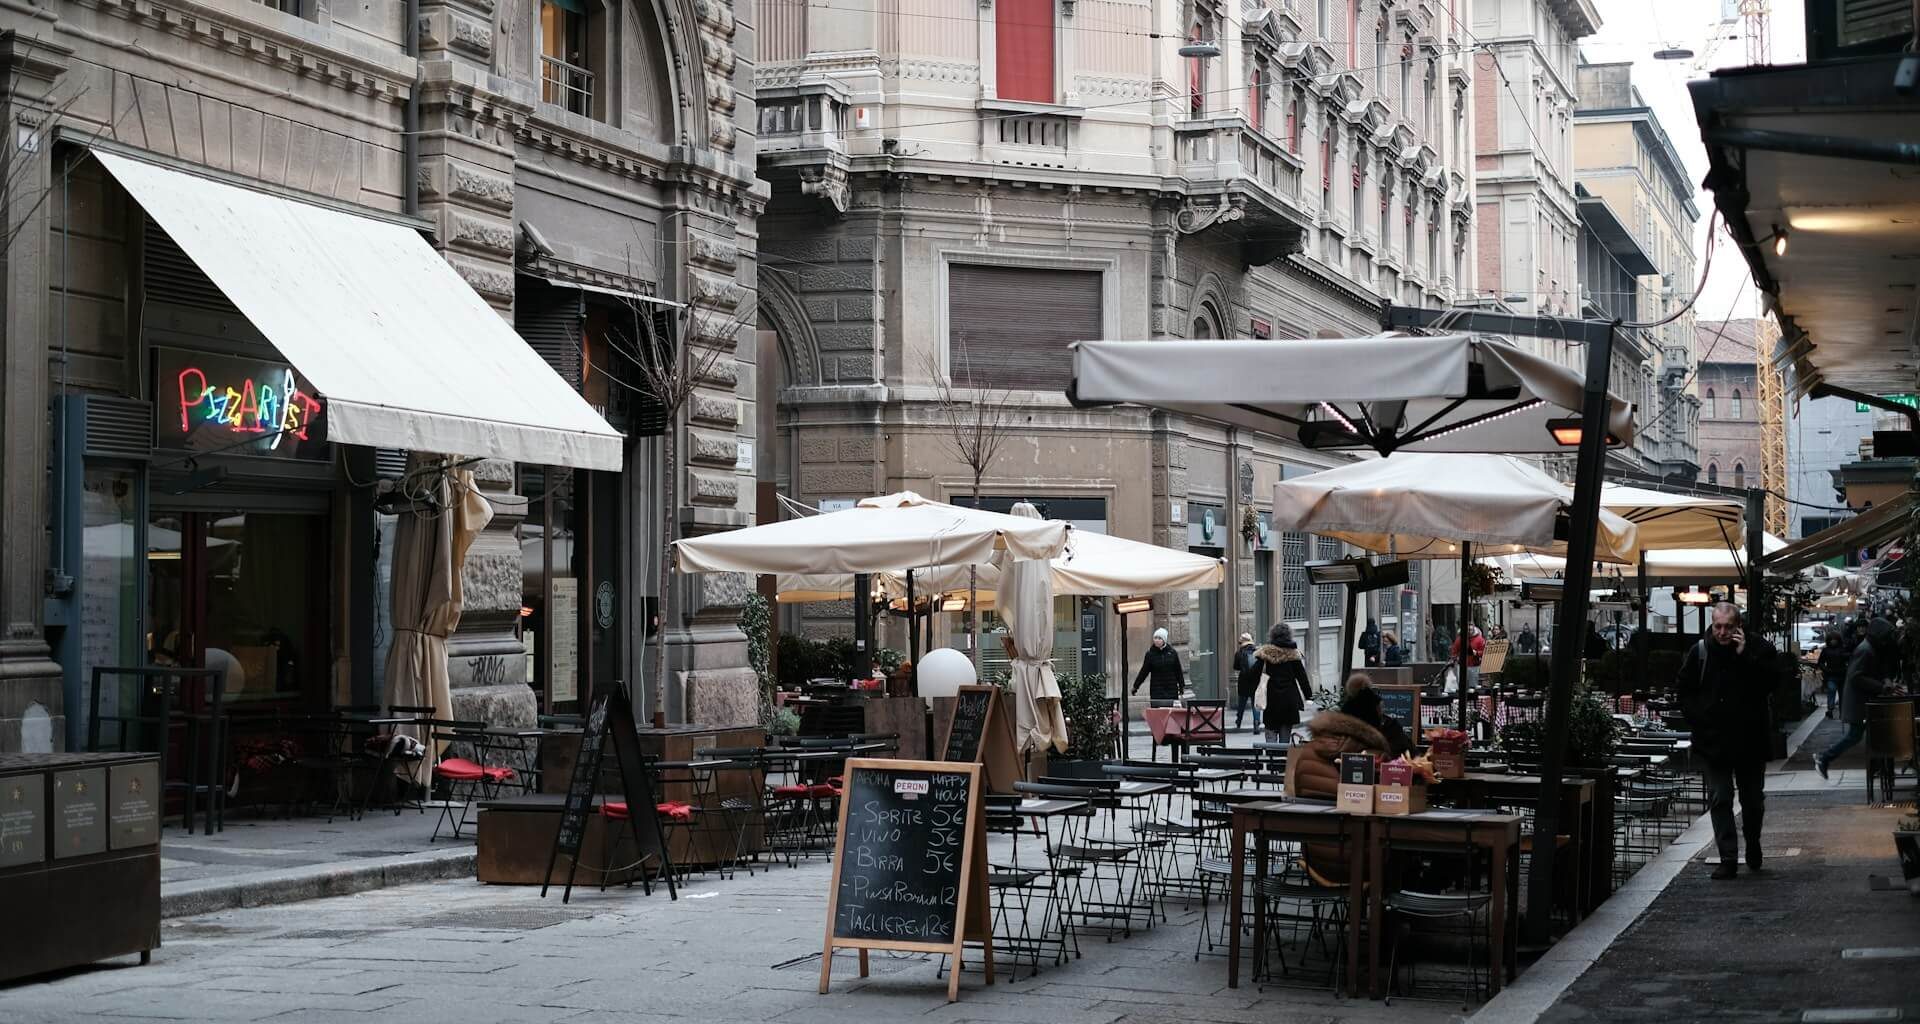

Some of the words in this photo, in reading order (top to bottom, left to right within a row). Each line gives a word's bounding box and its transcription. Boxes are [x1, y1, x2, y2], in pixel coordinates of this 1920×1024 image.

[895, 782, 928, 791] PERONI
[932, 773, 967, 787] HAPPY
[935, 789, 967, 803] HOUR
[931, 804, 964, 827] 5€
[862, 829, 901, 843] VINO
[928, 827, 960, 847] 5€
[857, 845, 904, 872] BIRRA
[922, 849, 954, 874] 5€
